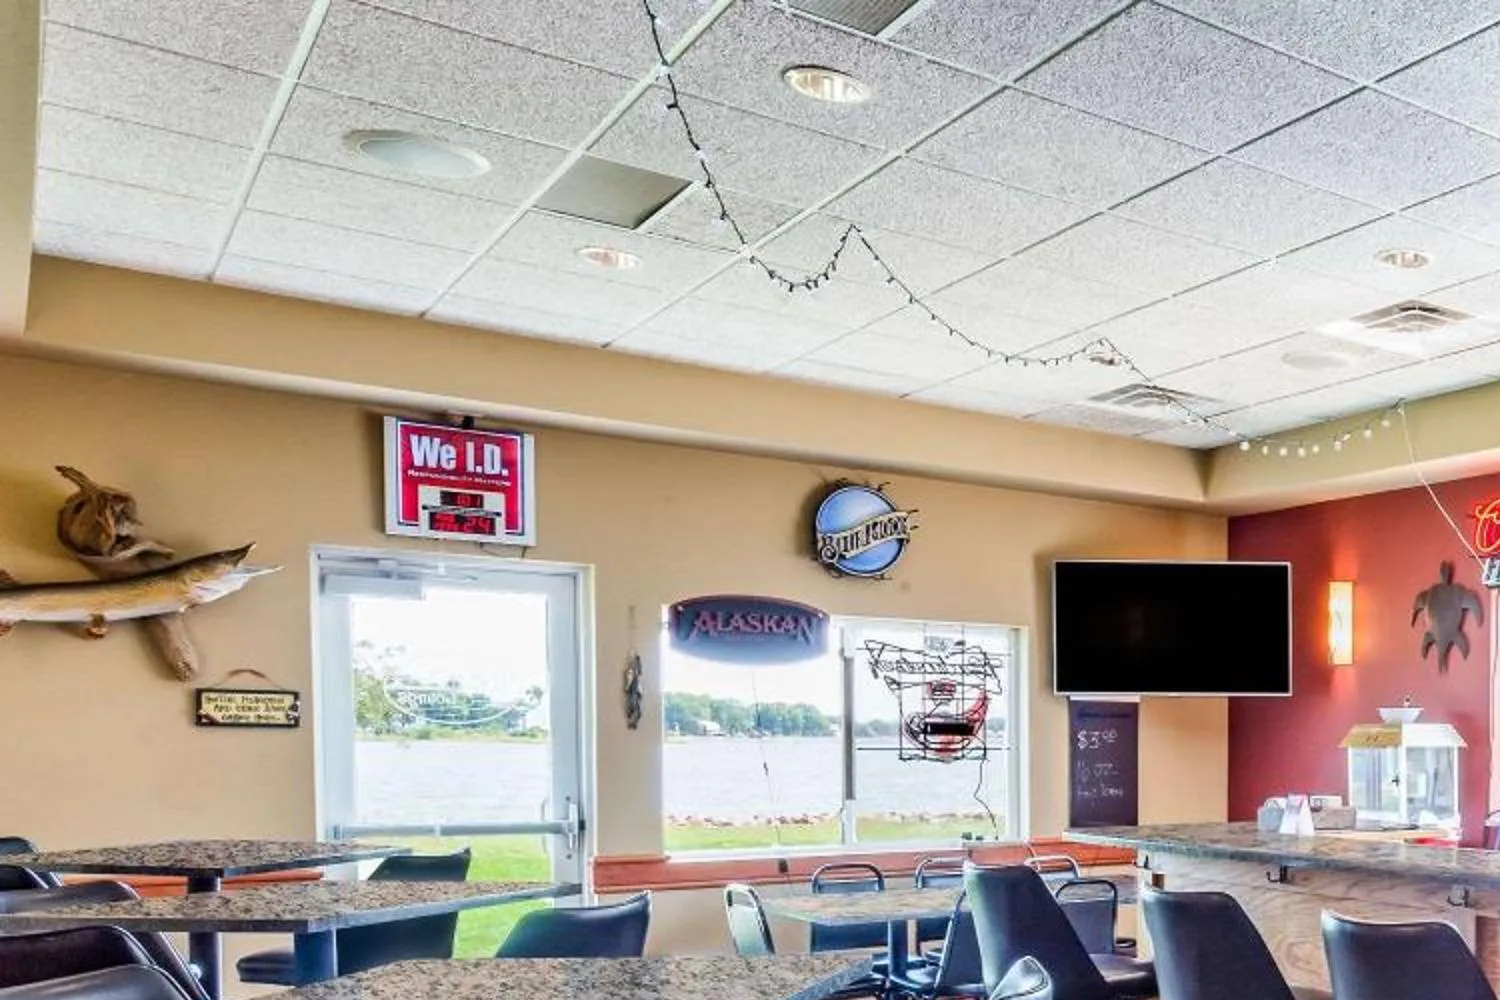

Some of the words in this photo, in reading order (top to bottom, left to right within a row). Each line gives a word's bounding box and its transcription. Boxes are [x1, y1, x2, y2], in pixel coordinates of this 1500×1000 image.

[410, 434, 456, 470] We
[466, 441, 509, 476] I.D.
[687, 610, 816, 644] ALASKAN
